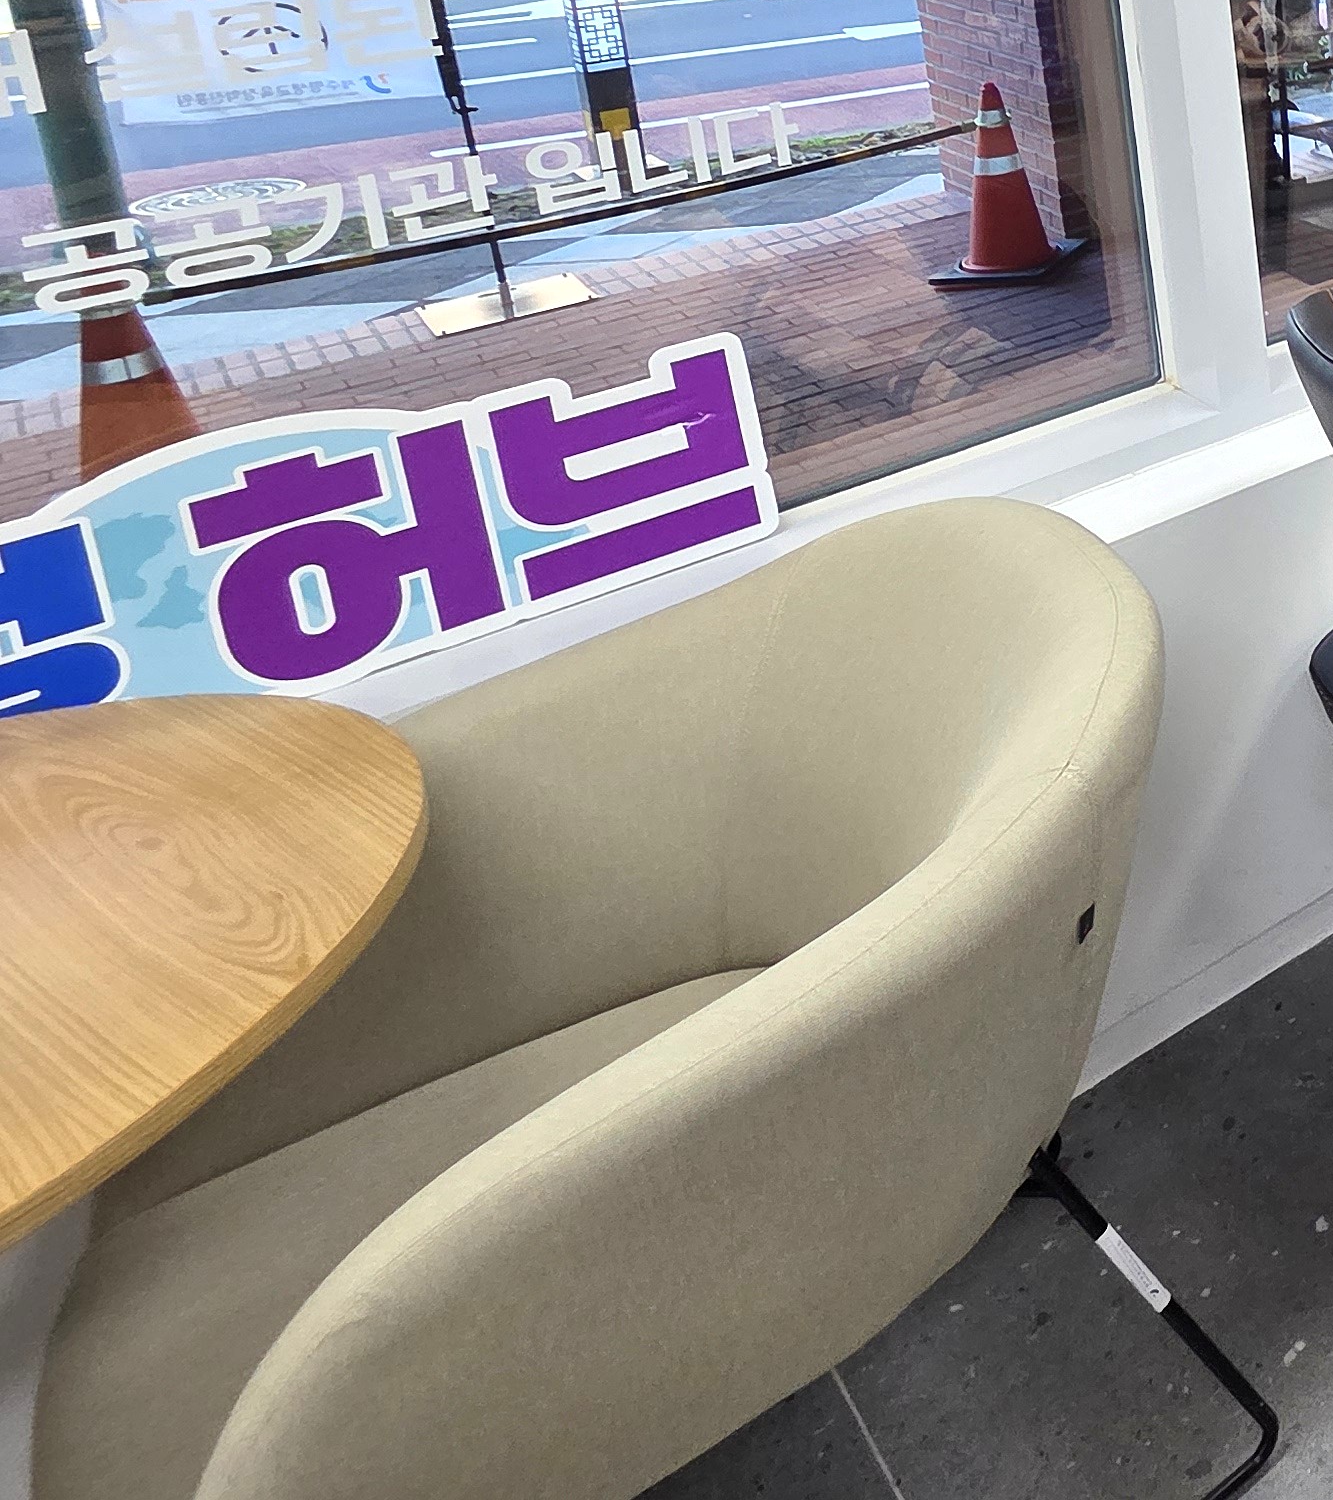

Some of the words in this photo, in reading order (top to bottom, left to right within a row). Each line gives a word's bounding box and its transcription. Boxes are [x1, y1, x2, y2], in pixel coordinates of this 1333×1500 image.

[22, 151, 500, 315] 공공기관
[524, 101, 800, 216] 입니다
[187, 347, 763, 682] 허브
